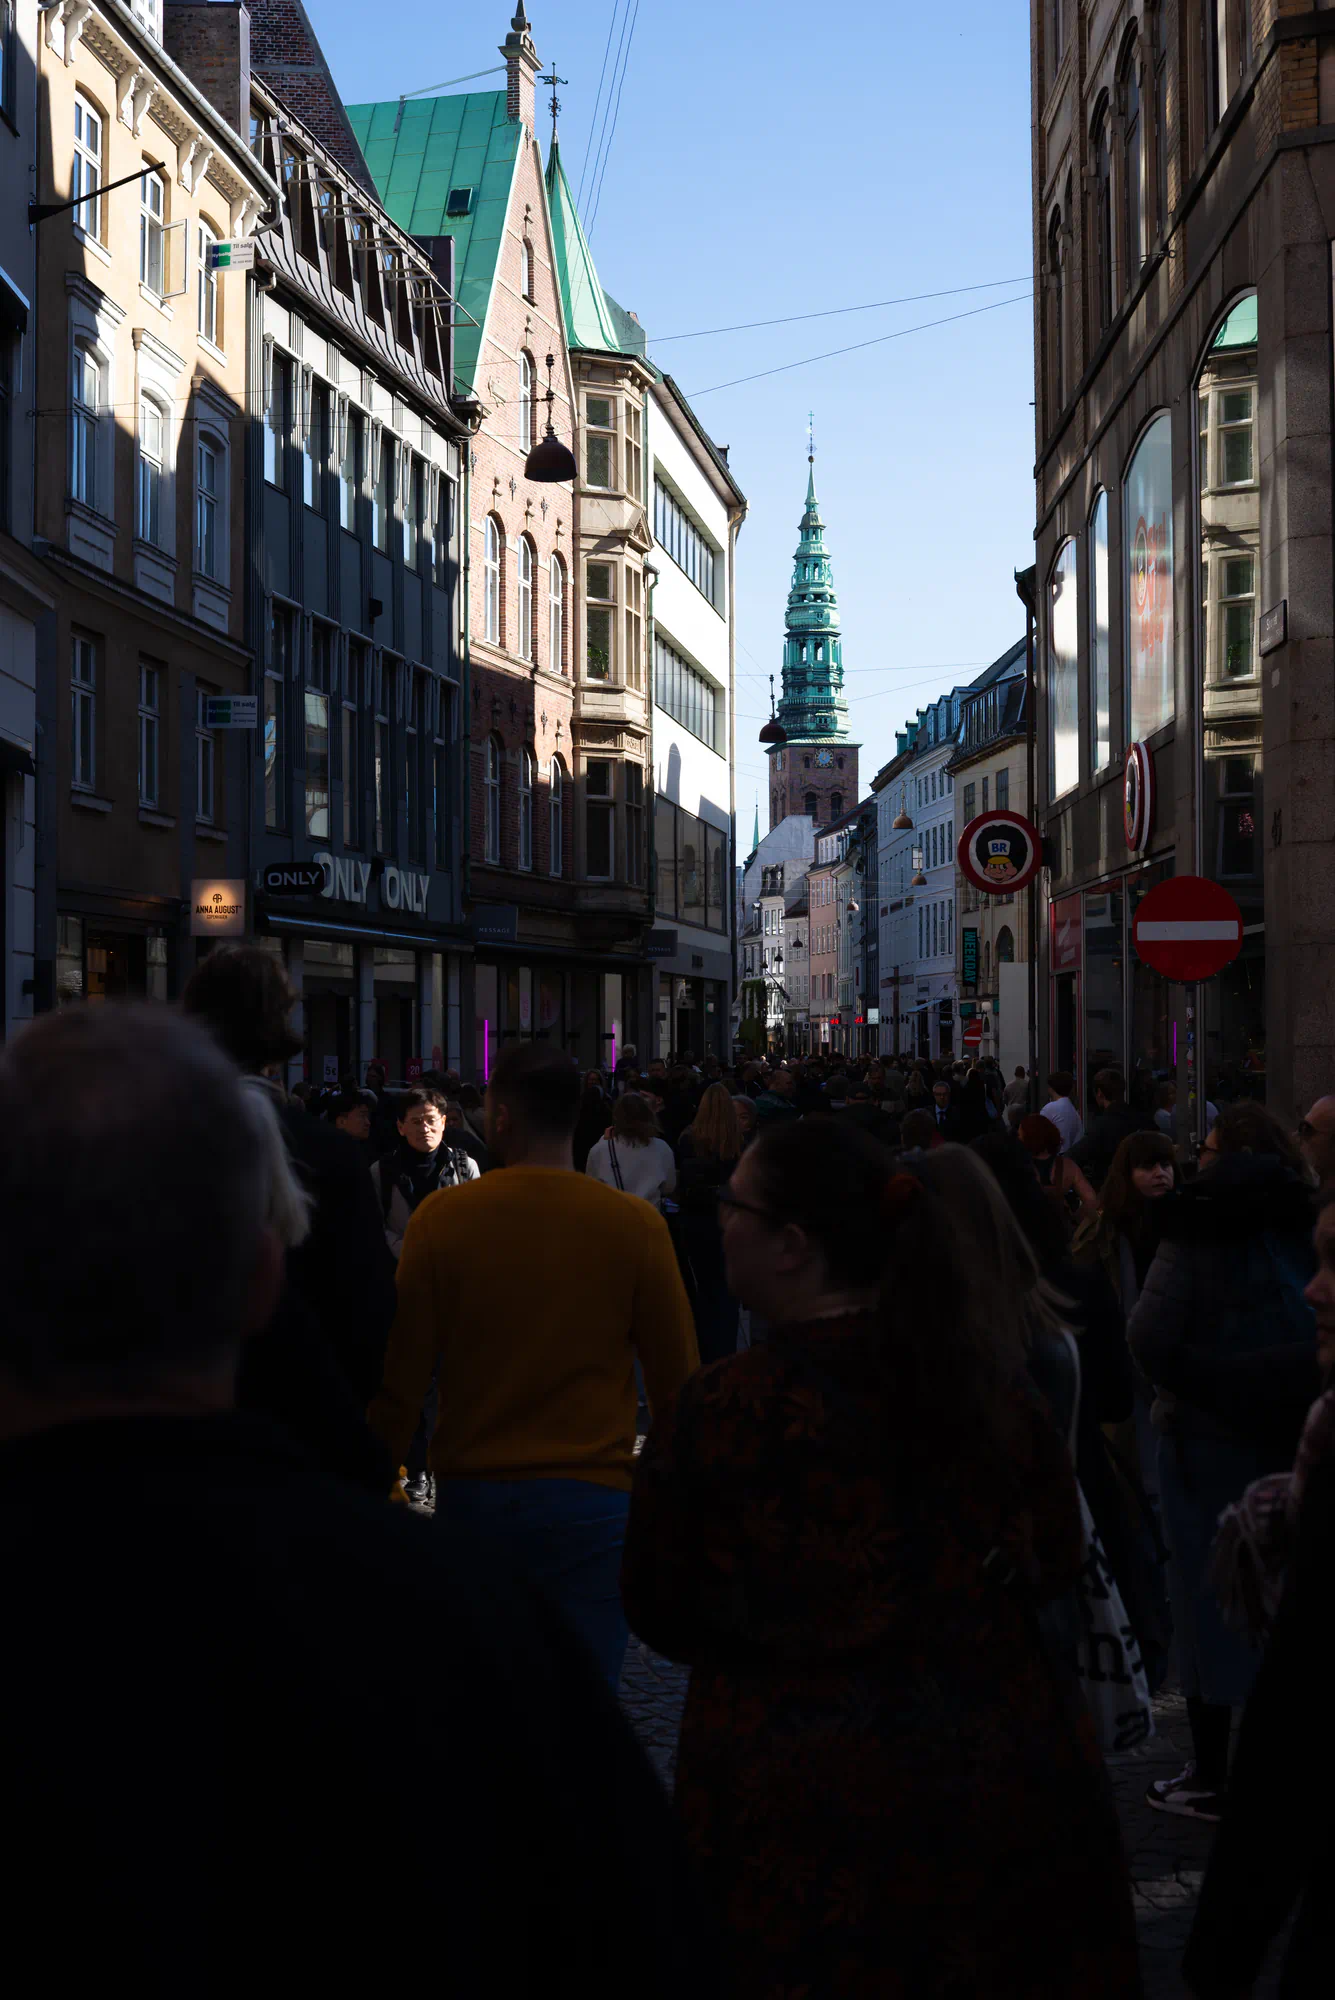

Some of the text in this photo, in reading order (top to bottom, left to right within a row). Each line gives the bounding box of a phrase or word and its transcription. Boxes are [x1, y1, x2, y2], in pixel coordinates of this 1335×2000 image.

[991, 842, 1007, 853] BR
[267, 870, 321, 887] ONLY
[312, 851, 430, 913] ONLY ONLY
[195, 905, 213, 914] ANNA
[964, 931, 977, 983] WEEKDAY
[325, 1066, 337, 1076] 5€
